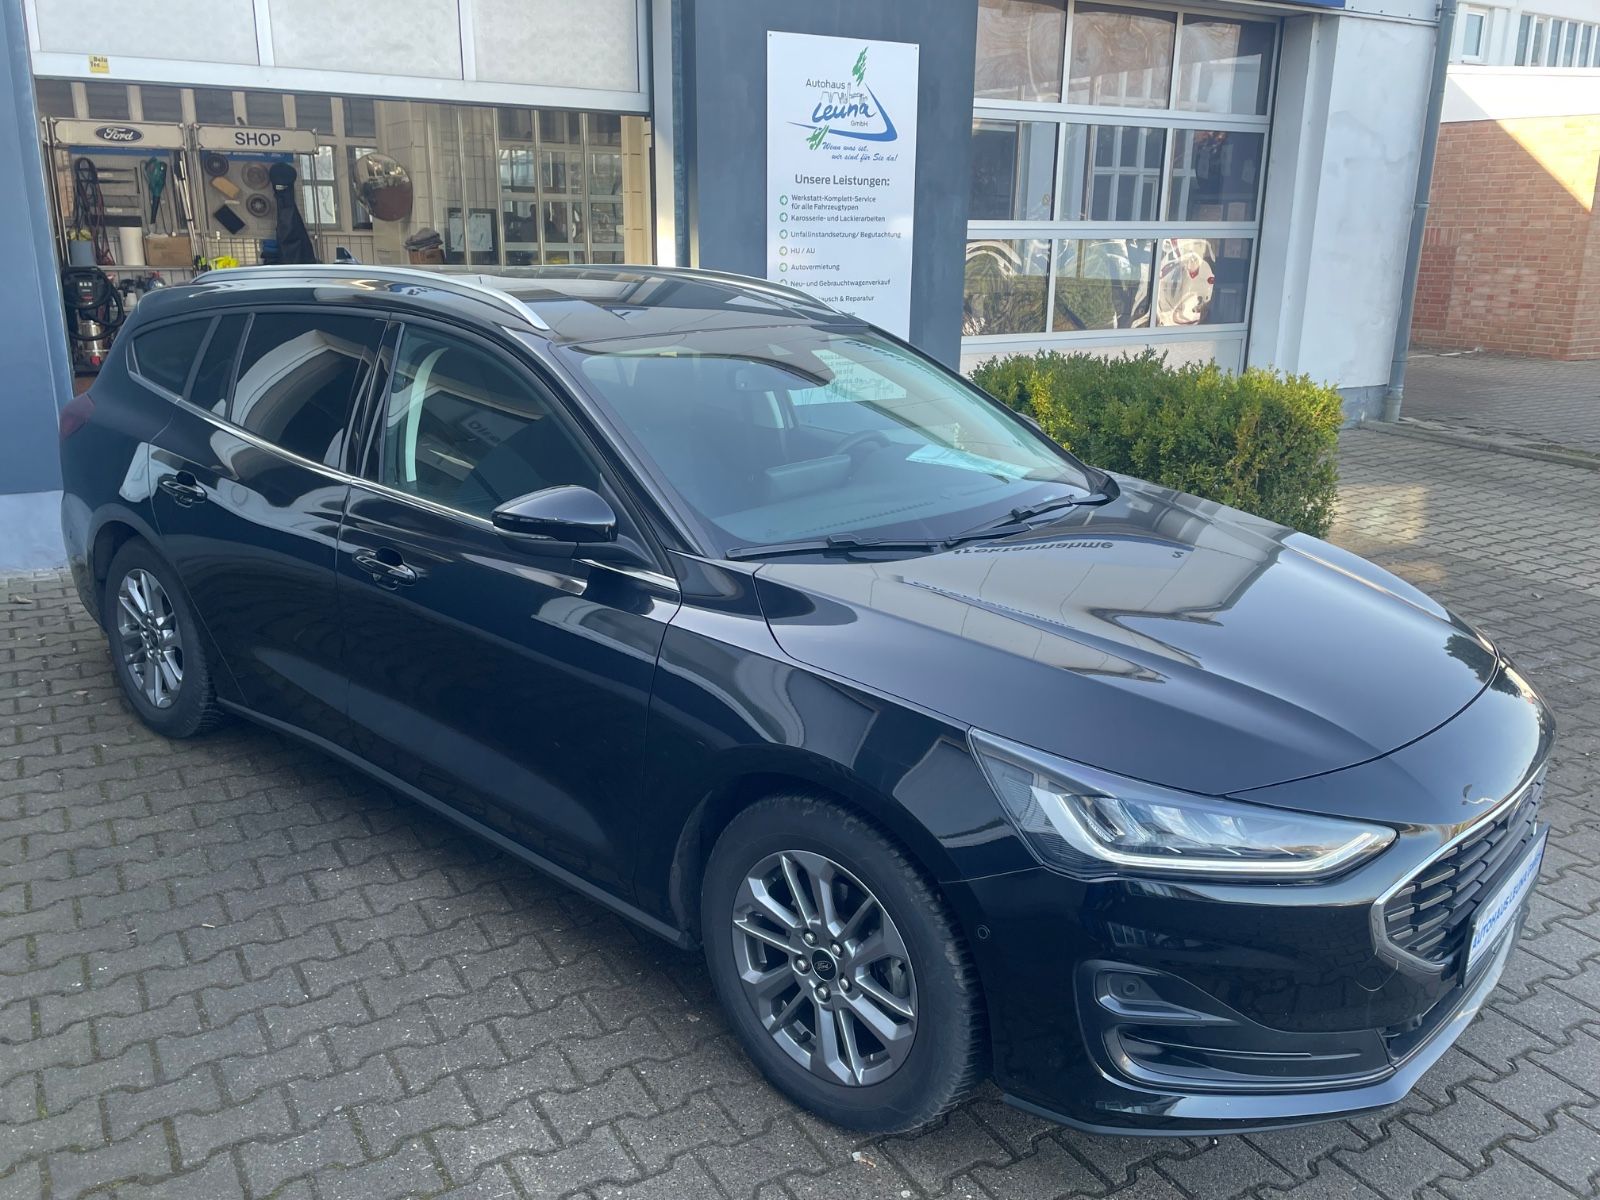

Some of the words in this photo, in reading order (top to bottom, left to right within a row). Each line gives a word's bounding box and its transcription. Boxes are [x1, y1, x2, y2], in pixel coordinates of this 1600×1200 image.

[805, 78, 846, 89] Autohaus
[811, 101, 877, 123] Leuna
[102, 127, 134, 141] Ford
[235, 132, 281, 147] SHOP
[822, 141, 841, 150] Wenn
[859, 153, 871, 163] für
[872, 153, 884, 161] Sie
[886, 153, 899, 161] da!
[794, 173, 831, 185] Unsere
[833, 175, 890, 188] Leistungen:
[791, 194, 876, 203] Werkstatt-Komplett-Service
[814, 204, 859, 212] Fahrzeugtypen
[860, 231, 902, 239] Begutachtung
[790, 263, 840, 271] Autovermietung
[820, 278, 891, 287] Gebrauchtwagenverkauf
[846, 295, 875, 303] Reparatur
